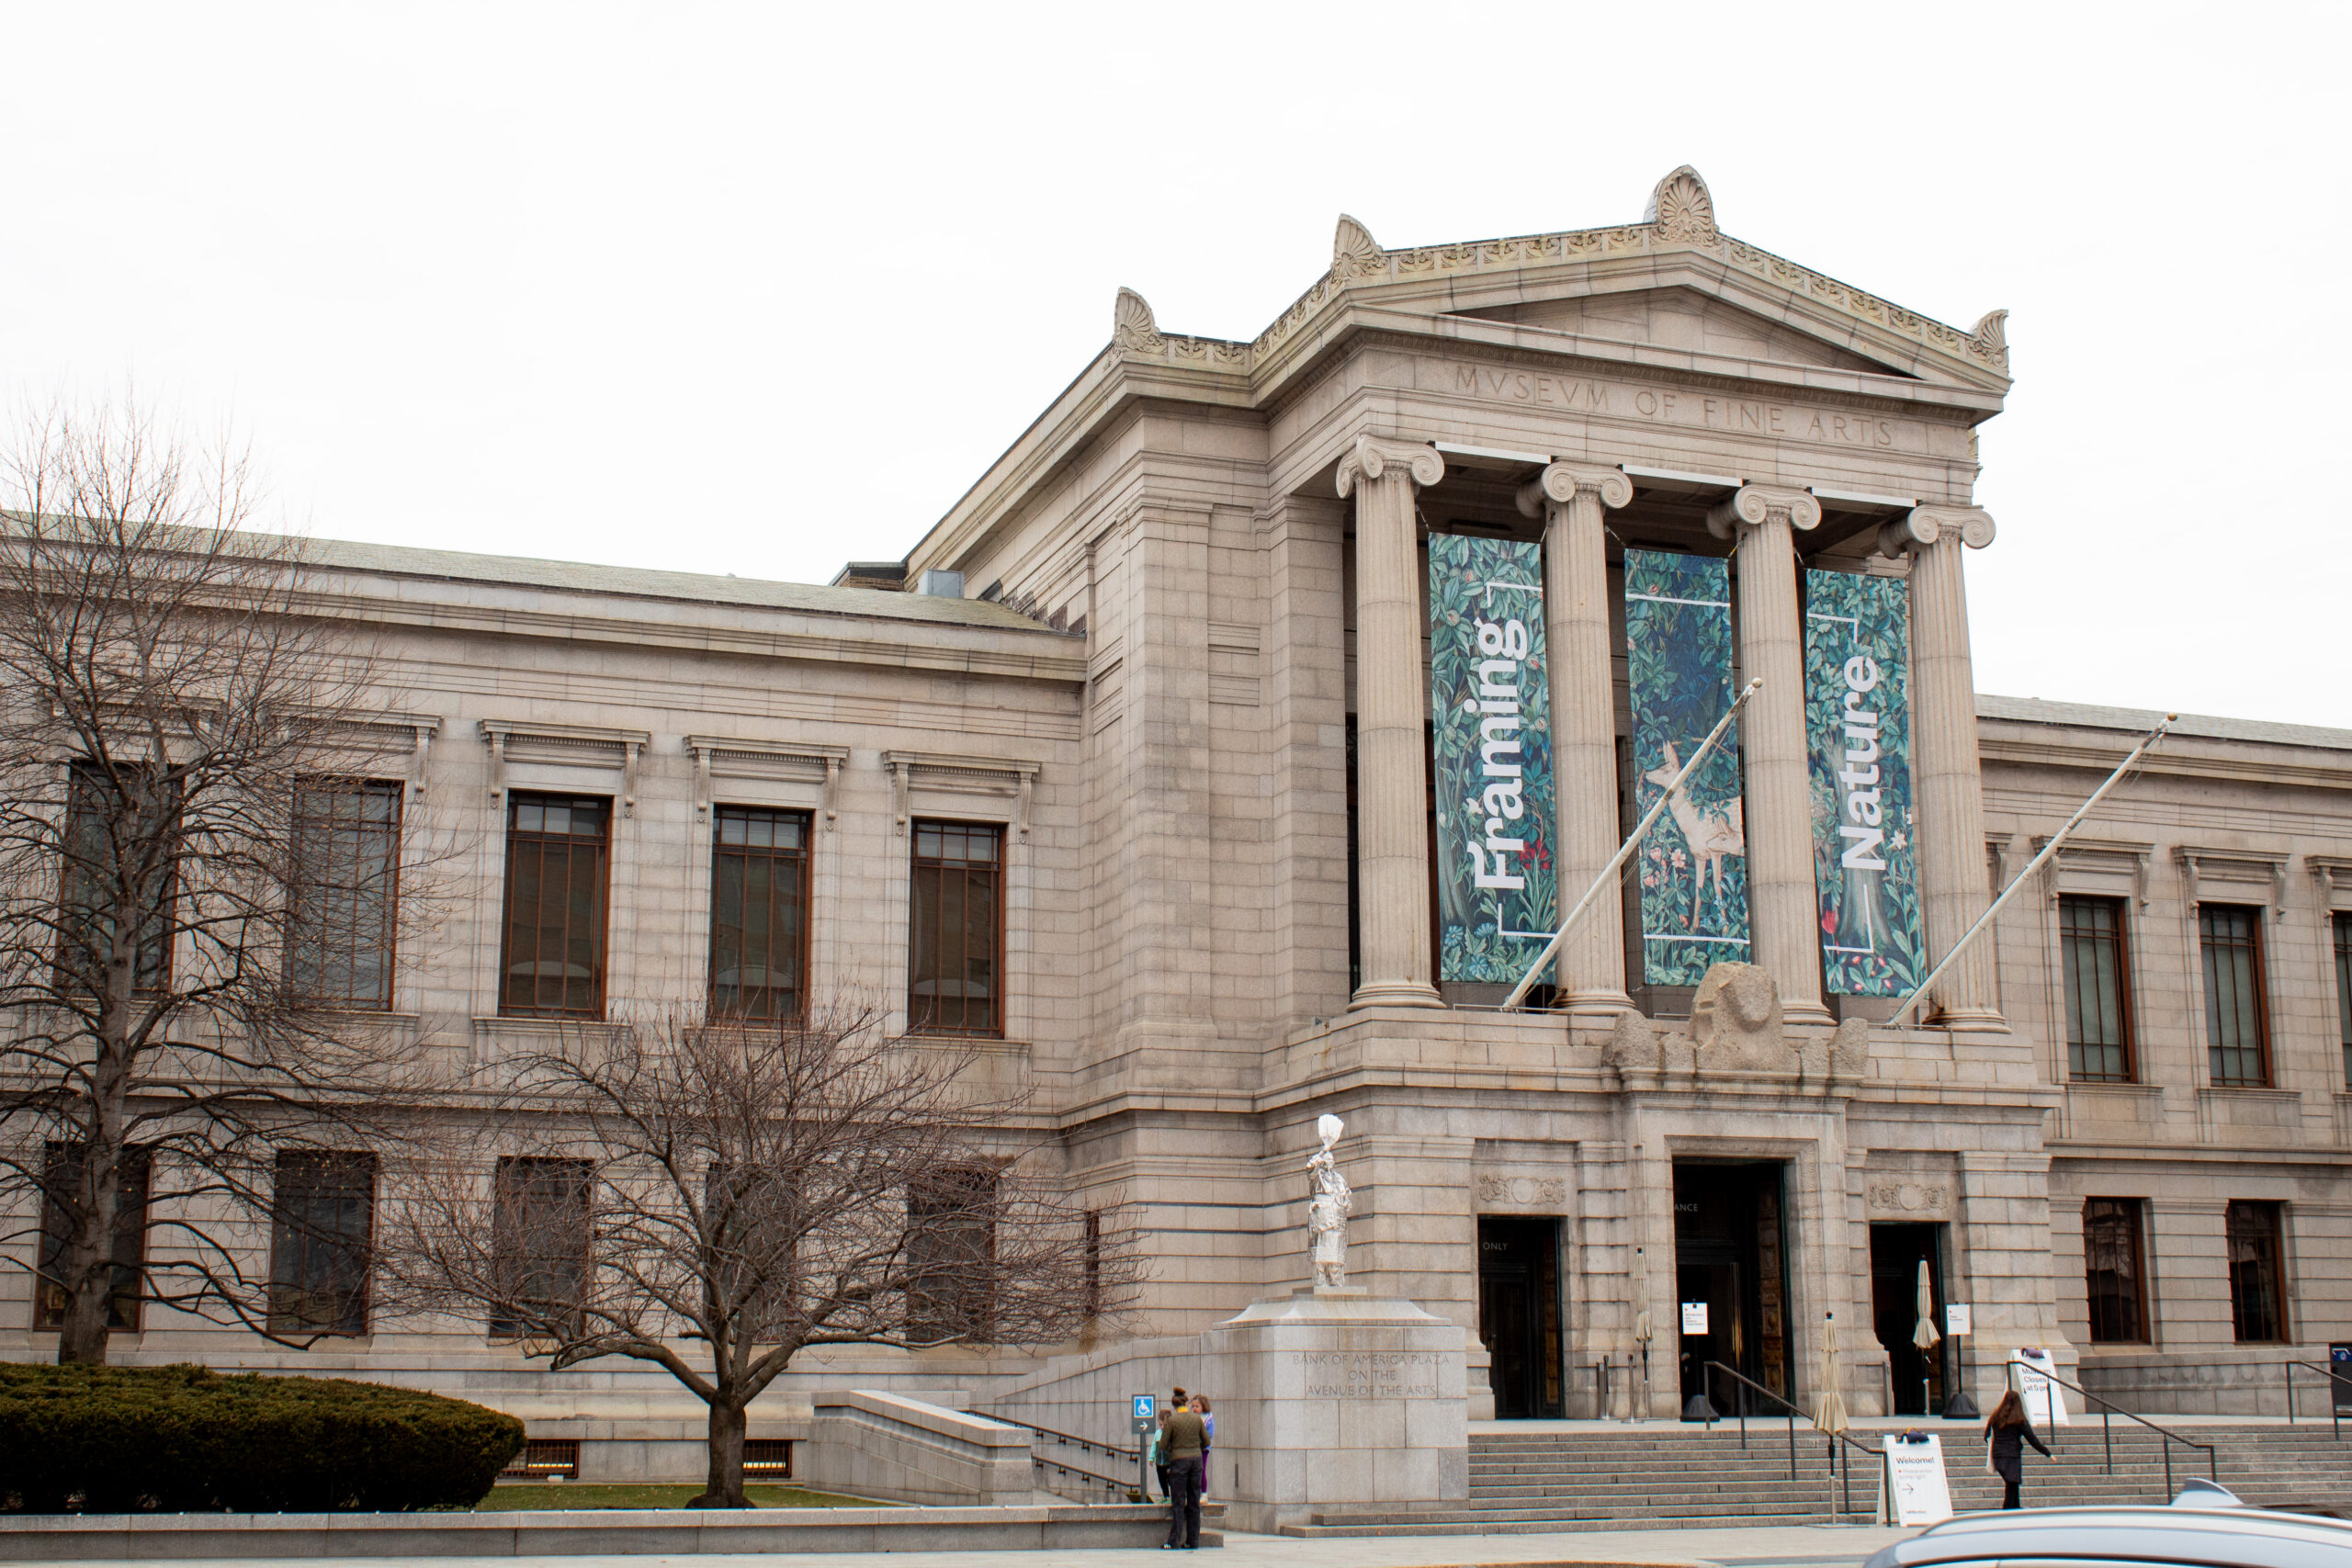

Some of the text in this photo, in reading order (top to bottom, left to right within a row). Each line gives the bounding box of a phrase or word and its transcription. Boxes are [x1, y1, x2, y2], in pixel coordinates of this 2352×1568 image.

[1455, 366, 1891, 446] MVSEVM OF FINE ARTS
[1464, 617, 1528, 889] Framing
[1838, 655, 1886, 870] Nature
[1482, 1242, 1508, 1250] ONLY
[1293, 1354, 1450, 1365] BANK OF AMERICA PLAZA
[1348, 1370, 1396, 1381] ON THE
[1306, 1385, 1435, 1395] AVENUE OF THE ARTS
[1895, 1456, 1934, 1464] Welcome!
